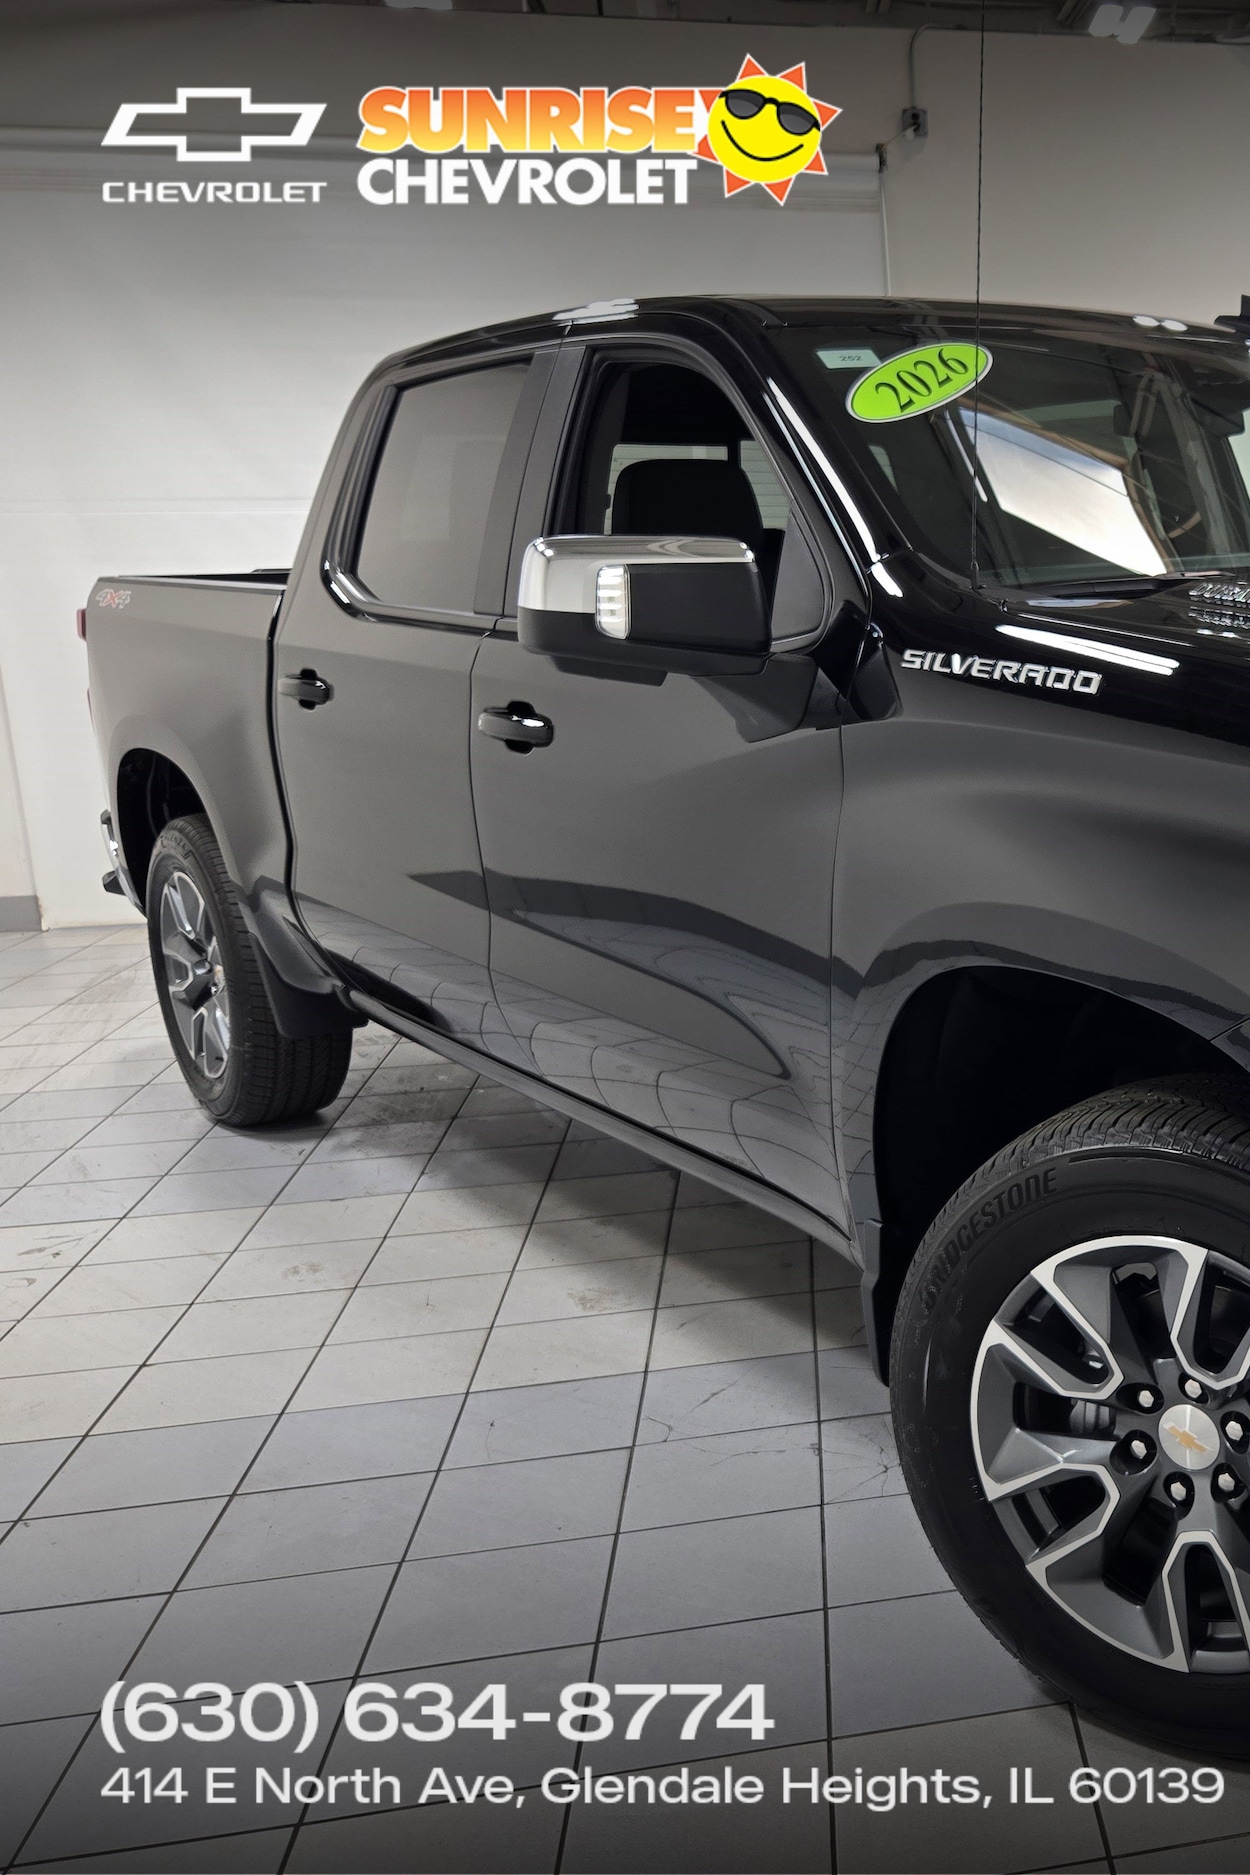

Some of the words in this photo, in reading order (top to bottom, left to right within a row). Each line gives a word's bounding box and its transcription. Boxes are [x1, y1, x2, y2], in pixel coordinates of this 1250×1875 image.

[875, 348, 969, 413] 2026
[901, 648, 1102, 695] SILVERADO
[920, 1168, 1058, 1313] BRIDGESTONE
